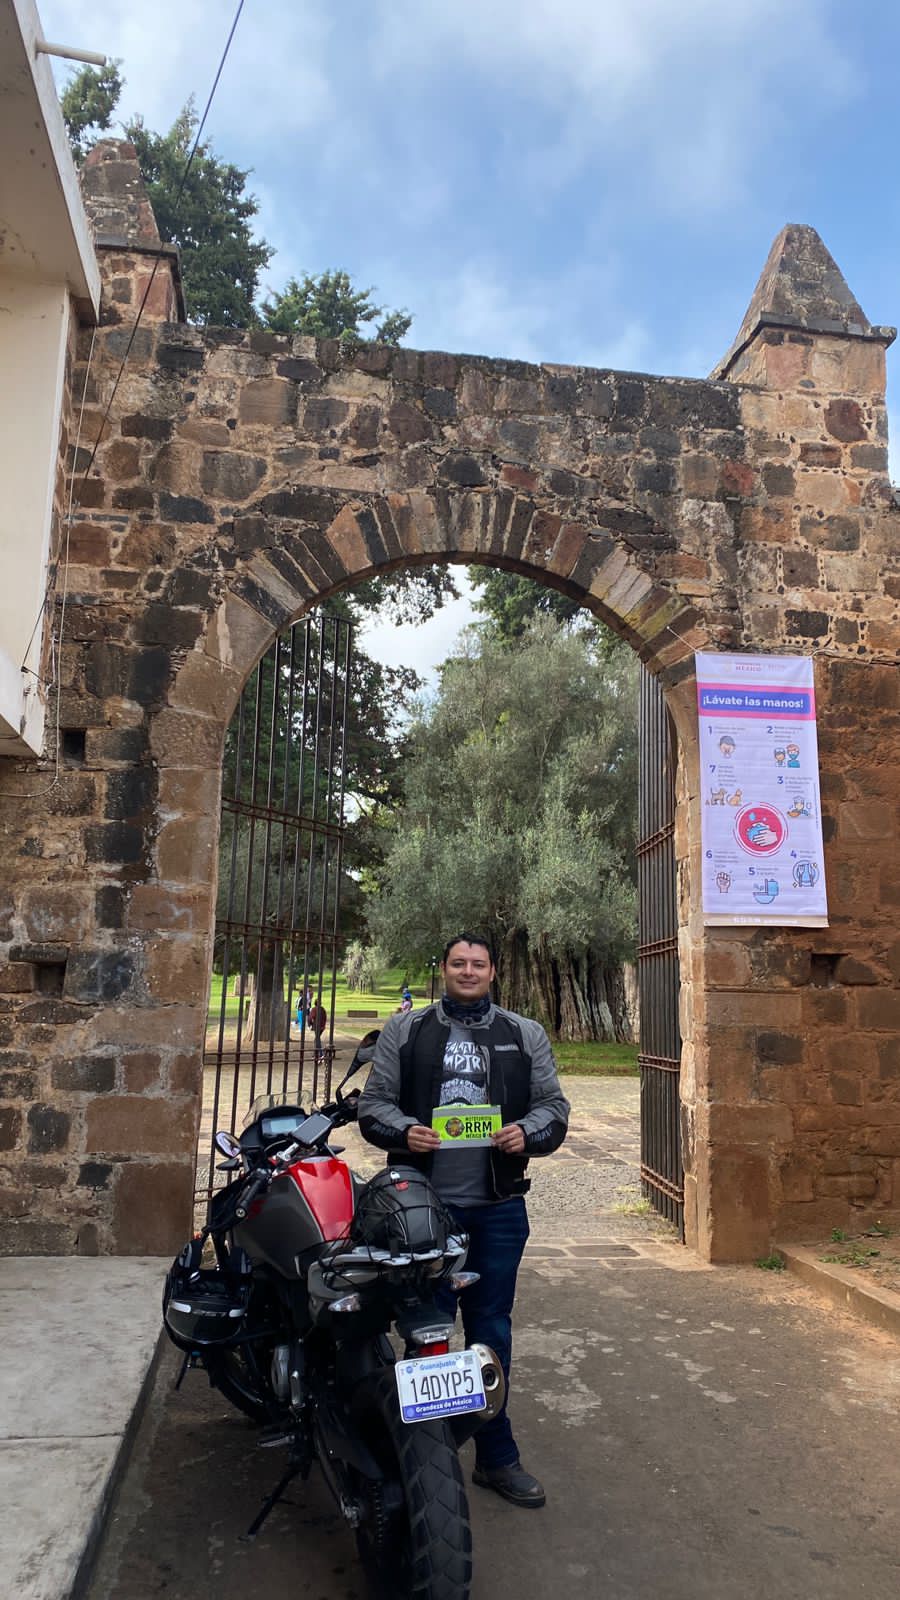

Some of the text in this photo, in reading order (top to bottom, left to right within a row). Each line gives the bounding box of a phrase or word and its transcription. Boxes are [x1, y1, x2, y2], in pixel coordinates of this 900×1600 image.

[703, 695, 804, 708] ¡Lávate las manos!
[708, 726, 713, 735] 1
[766, 726, 773, 734] 2
[709, 764, 716, 773] 7
[776, 776, 784, 784] 3
[705, 849, 713, 859] 6
[790, 850, 797, 858] 4
[748, 866, 756, 876] 5
[465, 1121, 492, 1133] RRM
[419, 1359, 457, 1371] Guanajuato
[410, 1369, 474, 1403] 14DYP5
[415, 1403, 444, 1413] Grandeza
[452, 1398, 473, 1406] México
